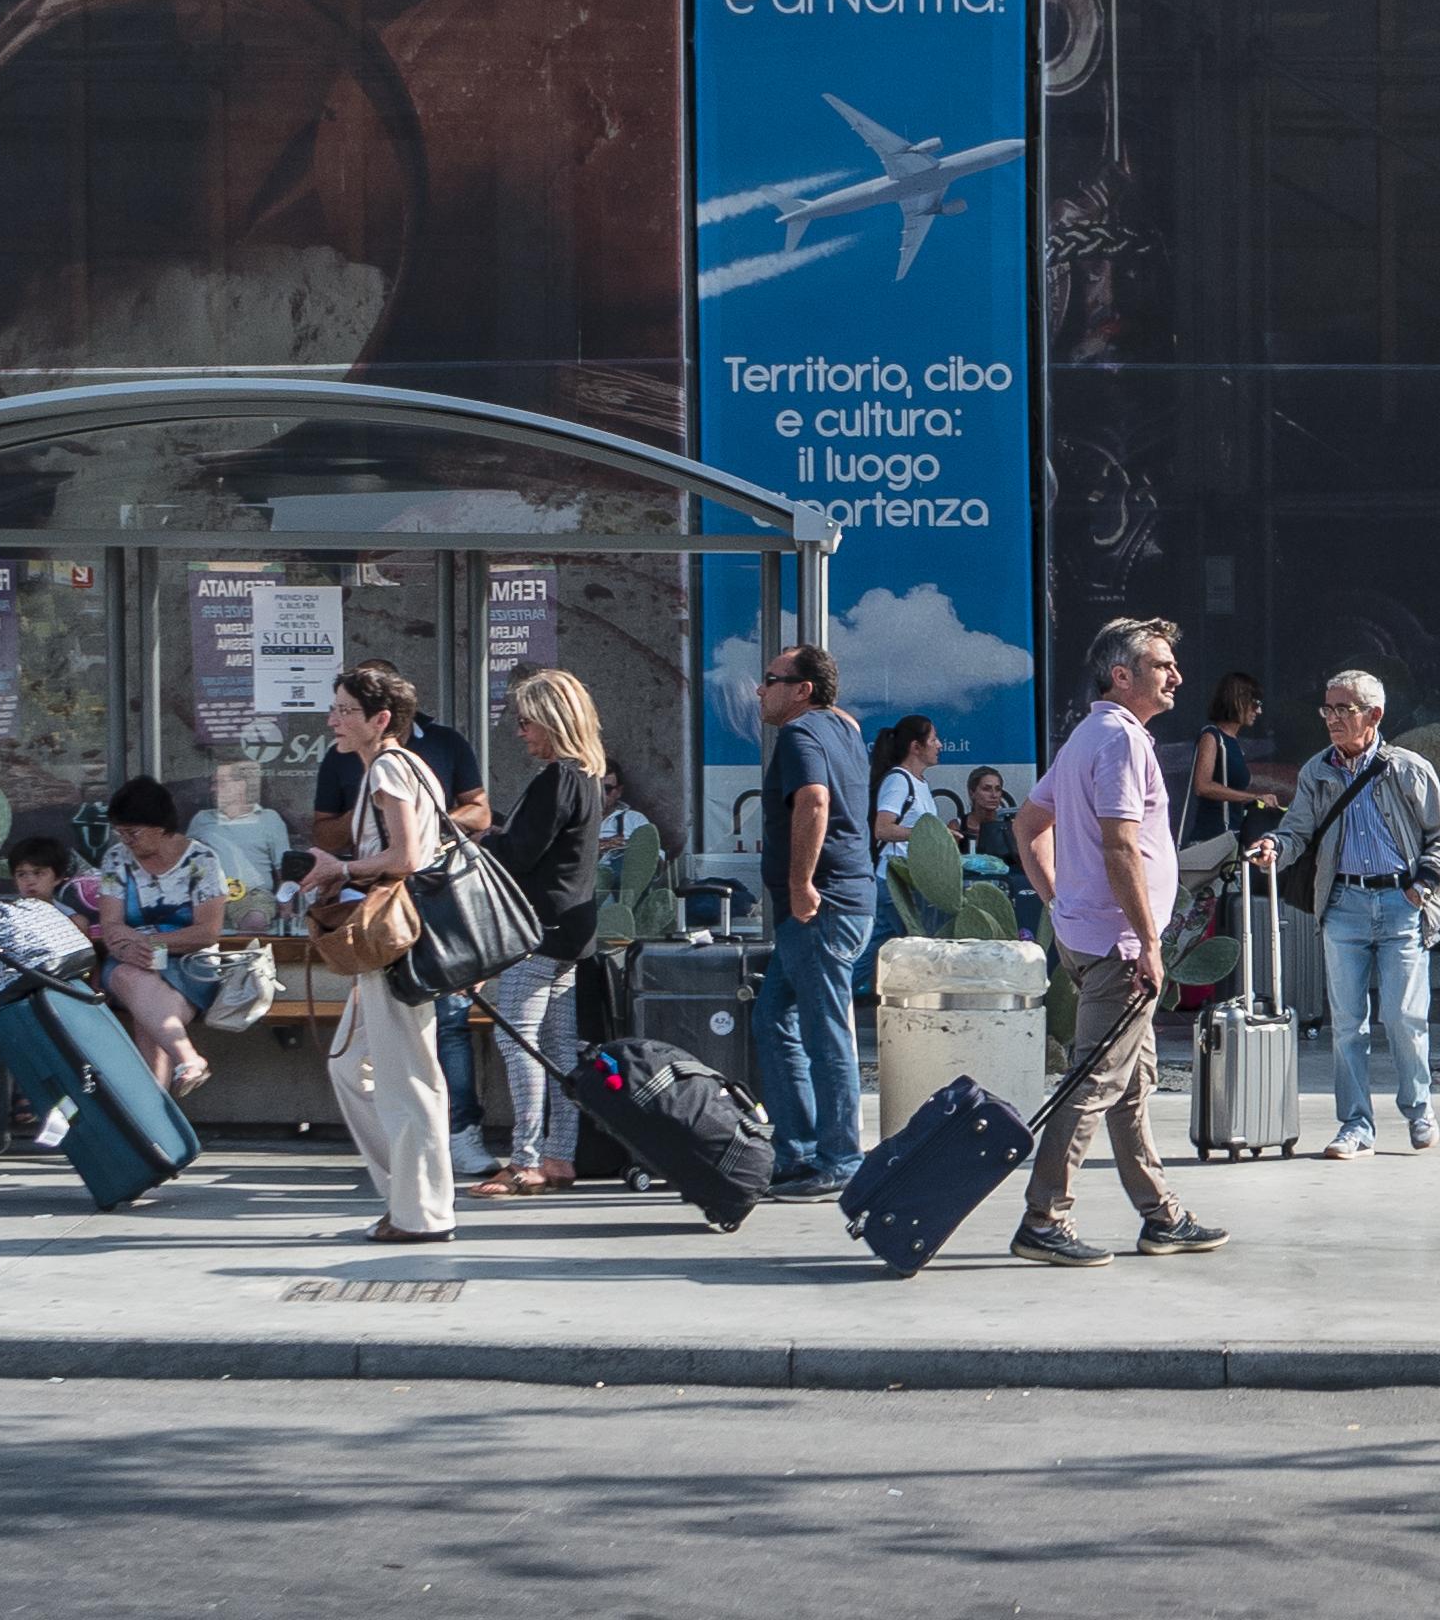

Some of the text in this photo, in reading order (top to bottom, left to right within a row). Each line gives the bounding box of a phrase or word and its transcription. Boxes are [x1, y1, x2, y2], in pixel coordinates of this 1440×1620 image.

[723, 356, 1012, 399] Territorio, cibo
[775, 403, 963, 438] e cultura:
[798, 447, 941, 492] il luogo
[262, 632, 332, 645] SICILIA
[284, 734, 338, 763] SA
